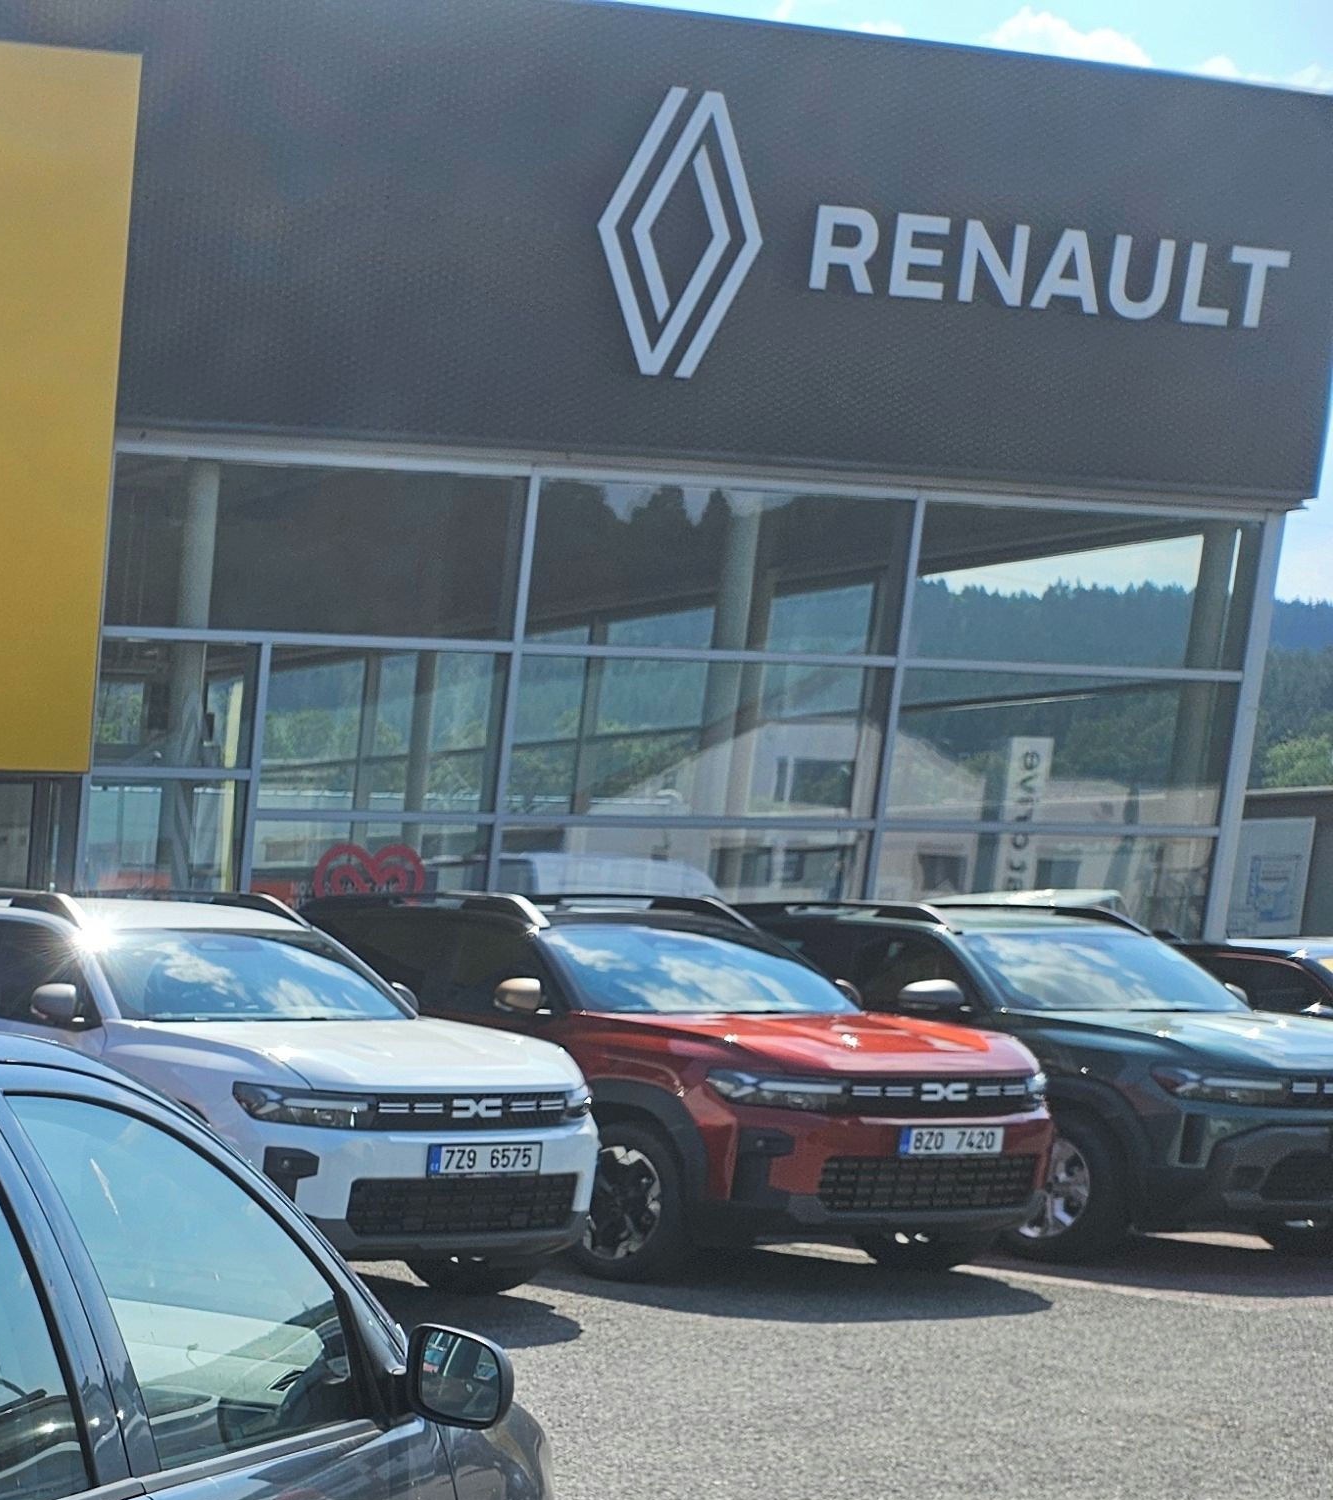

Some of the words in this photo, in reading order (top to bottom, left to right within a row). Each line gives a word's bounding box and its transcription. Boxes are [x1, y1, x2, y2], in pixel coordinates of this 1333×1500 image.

[808, 203, 1292, 329] RENAULT
[955, 1131, 996, 1150] 7420
[444, 1149, 477, 1170] 7Z9
[490, 1147, 532, 1169] 6575
